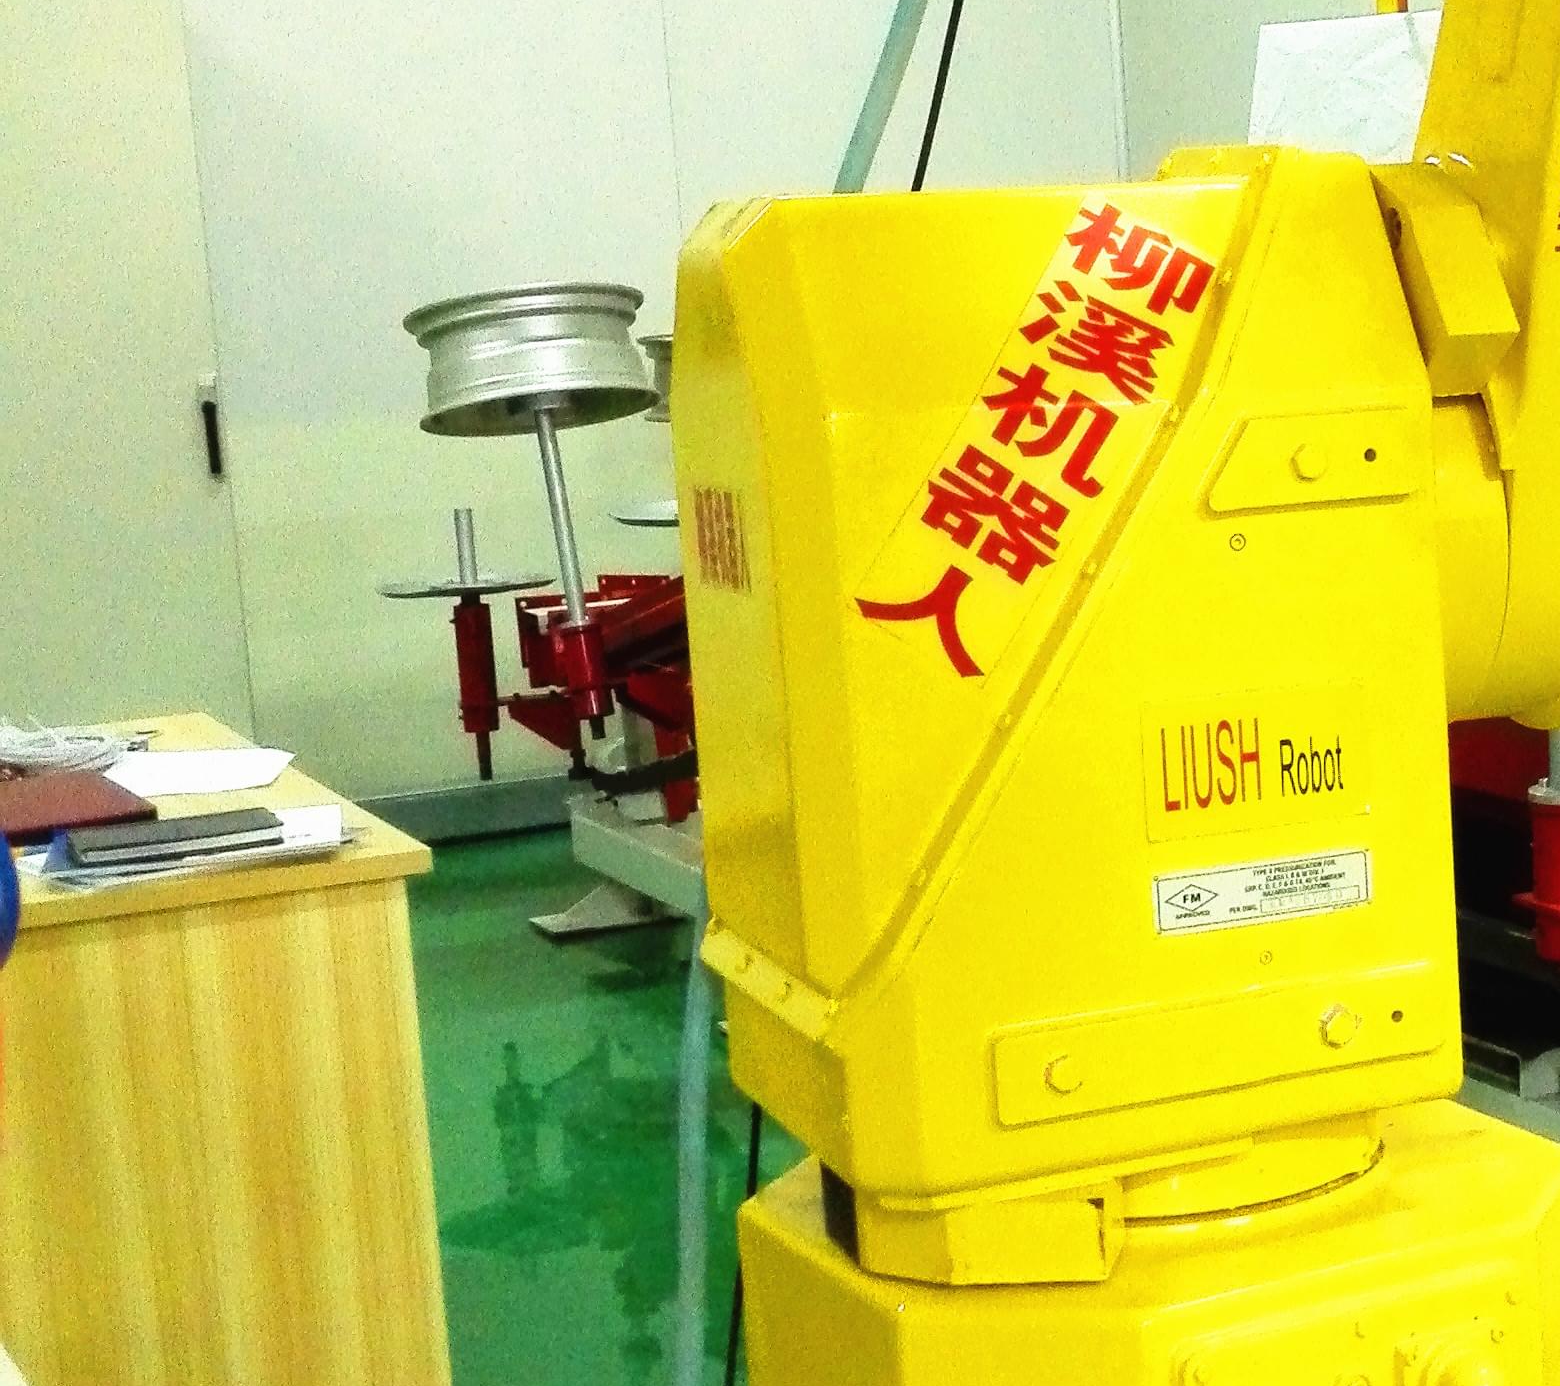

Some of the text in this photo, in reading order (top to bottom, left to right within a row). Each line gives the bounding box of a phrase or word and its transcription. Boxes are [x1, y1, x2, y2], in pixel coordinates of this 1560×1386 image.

[854, 203, 1215, 678] 柳溪机器人
[1160, 718, 1344, 812] LIUSH Robot
[1183, 893, 1201, 903] FM
